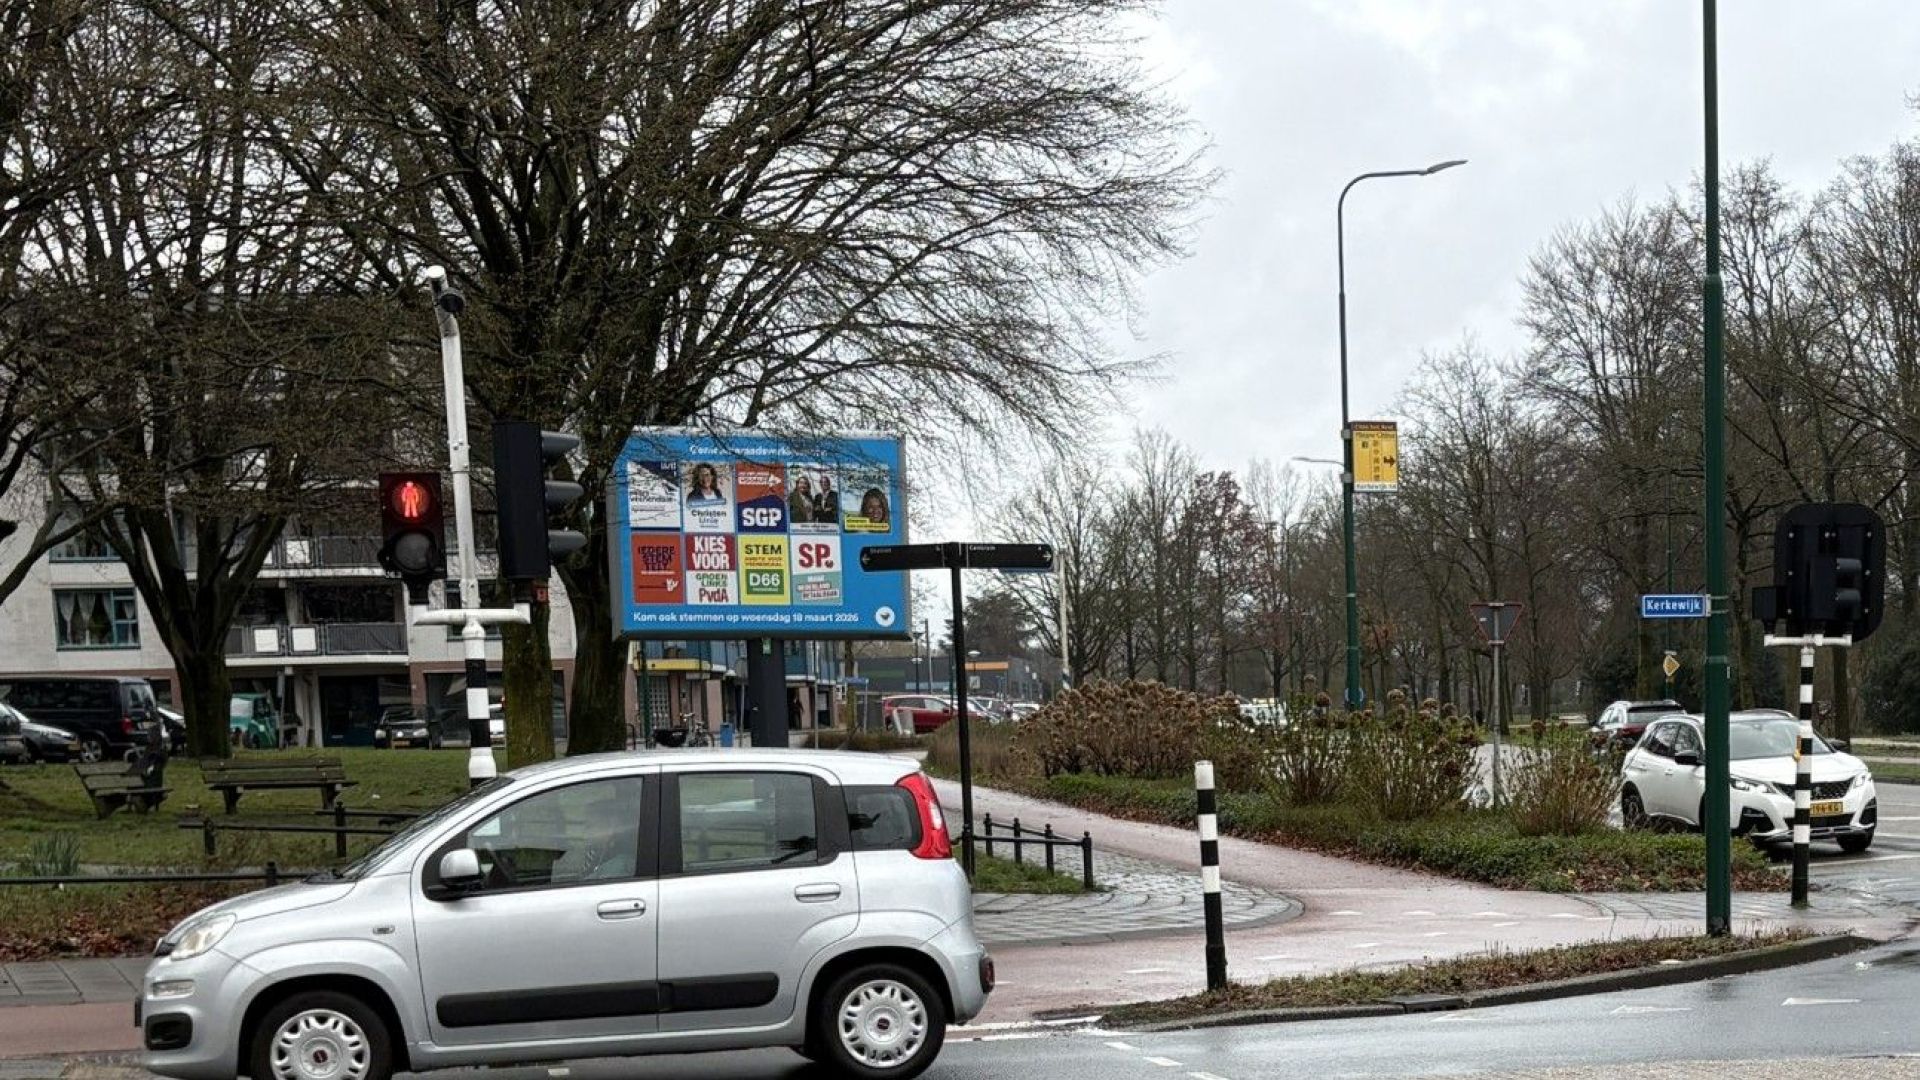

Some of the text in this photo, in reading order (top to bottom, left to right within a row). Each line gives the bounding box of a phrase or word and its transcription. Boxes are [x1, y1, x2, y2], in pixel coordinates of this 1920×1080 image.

[742, 508, 782, 527] SGP
[694, 536, 726, 552] KIES
[744, 544, 782, 554] STEM
[692, 553, 730, 570] VOOR
[749, 572, 781, 587] D66
[699, 587, 729, 603] PvdA
[1646, 599, 1701, 612] Kerkewijk
[633, 612, 657, 622] Kom
[658, 612, 677, 621] ook
[679, 613, 724, 621] stemmen
[726, 613, 739, 623] op
[741, 612, 791, 623] woensdag
[805, 613, 833, 622] maart
[835, 613, 859, 622] 2026
